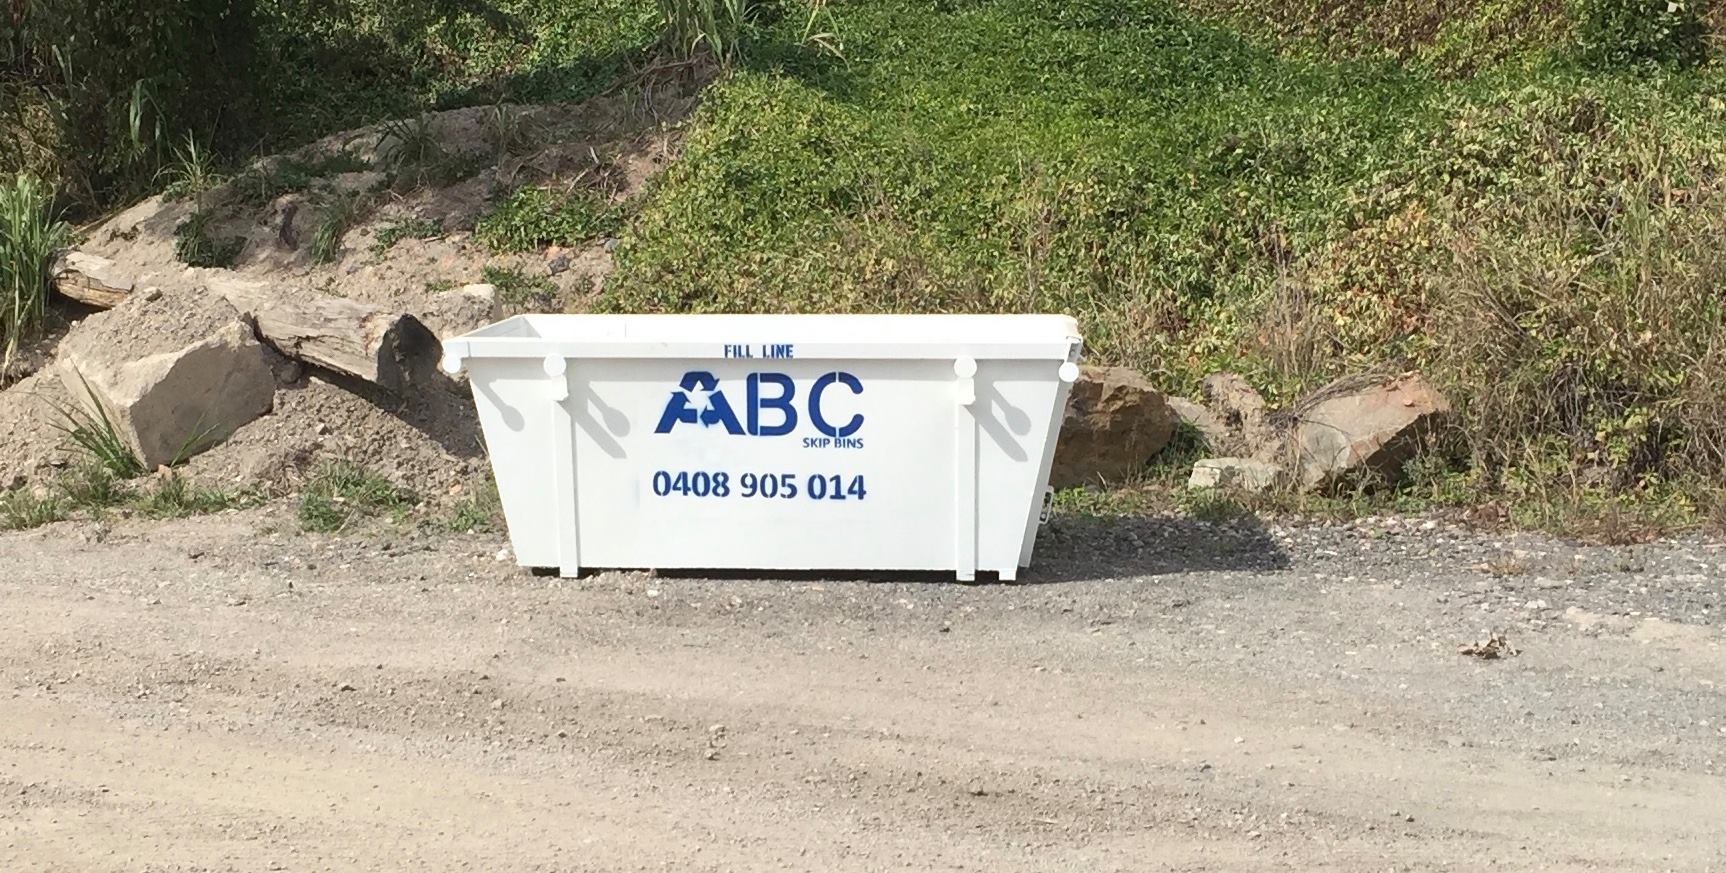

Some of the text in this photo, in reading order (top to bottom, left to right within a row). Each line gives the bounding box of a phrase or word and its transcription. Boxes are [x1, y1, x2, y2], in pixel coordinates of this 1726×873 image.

[724, 344, 794, 359] FILL LINE
[654, 370, 865, 438] ABC
[802, 437, 864, 449] SKIP BINS
[652, 470, 867, 501] 0408 905 014
